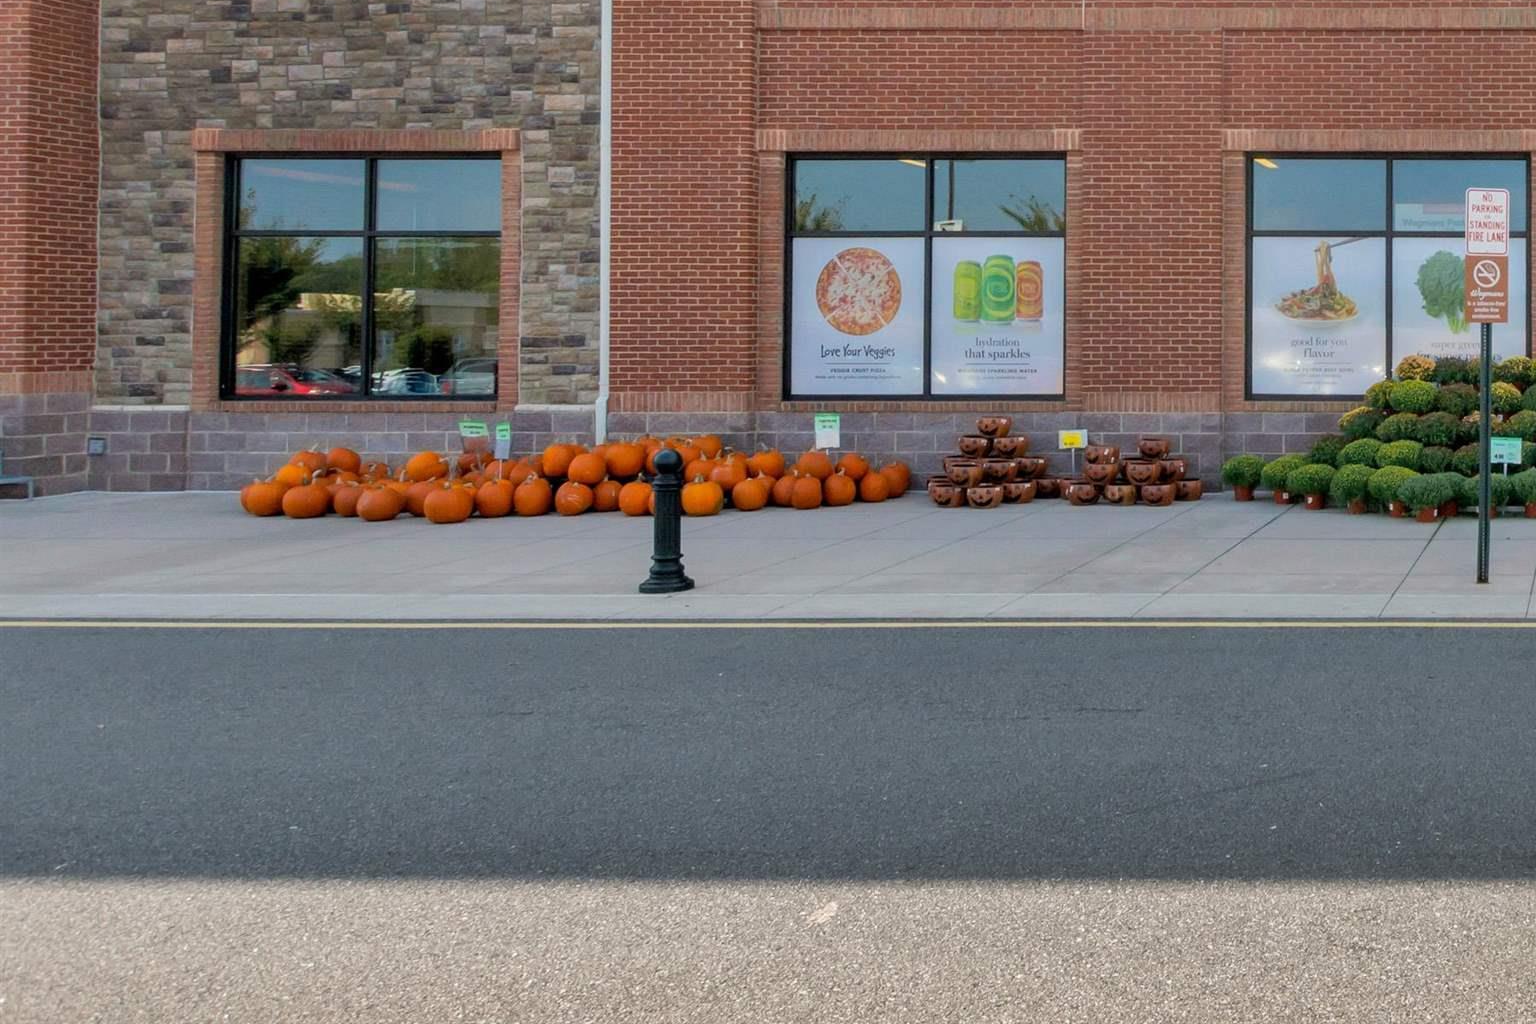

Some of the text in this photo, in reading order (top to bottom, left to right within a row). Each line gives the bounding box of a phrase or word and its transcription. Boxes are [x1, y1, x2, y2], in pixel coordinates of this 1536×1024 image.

[1482, 194, 1493, 202] NO
[1471, 204, 1503, 213] PARKING
[1469, 221, 1505, 230] STANDING
[1469, 232, 1505, 242] FIRE LANE
[975, 337, 1020, 349] hydration
[1315, 337, 1328, 346] for
[820, 344, 896, 359] Love Your Veggies
[964, 348, 1031, 360] that sparkles
[1303, 348, 1335, 358] flavor
